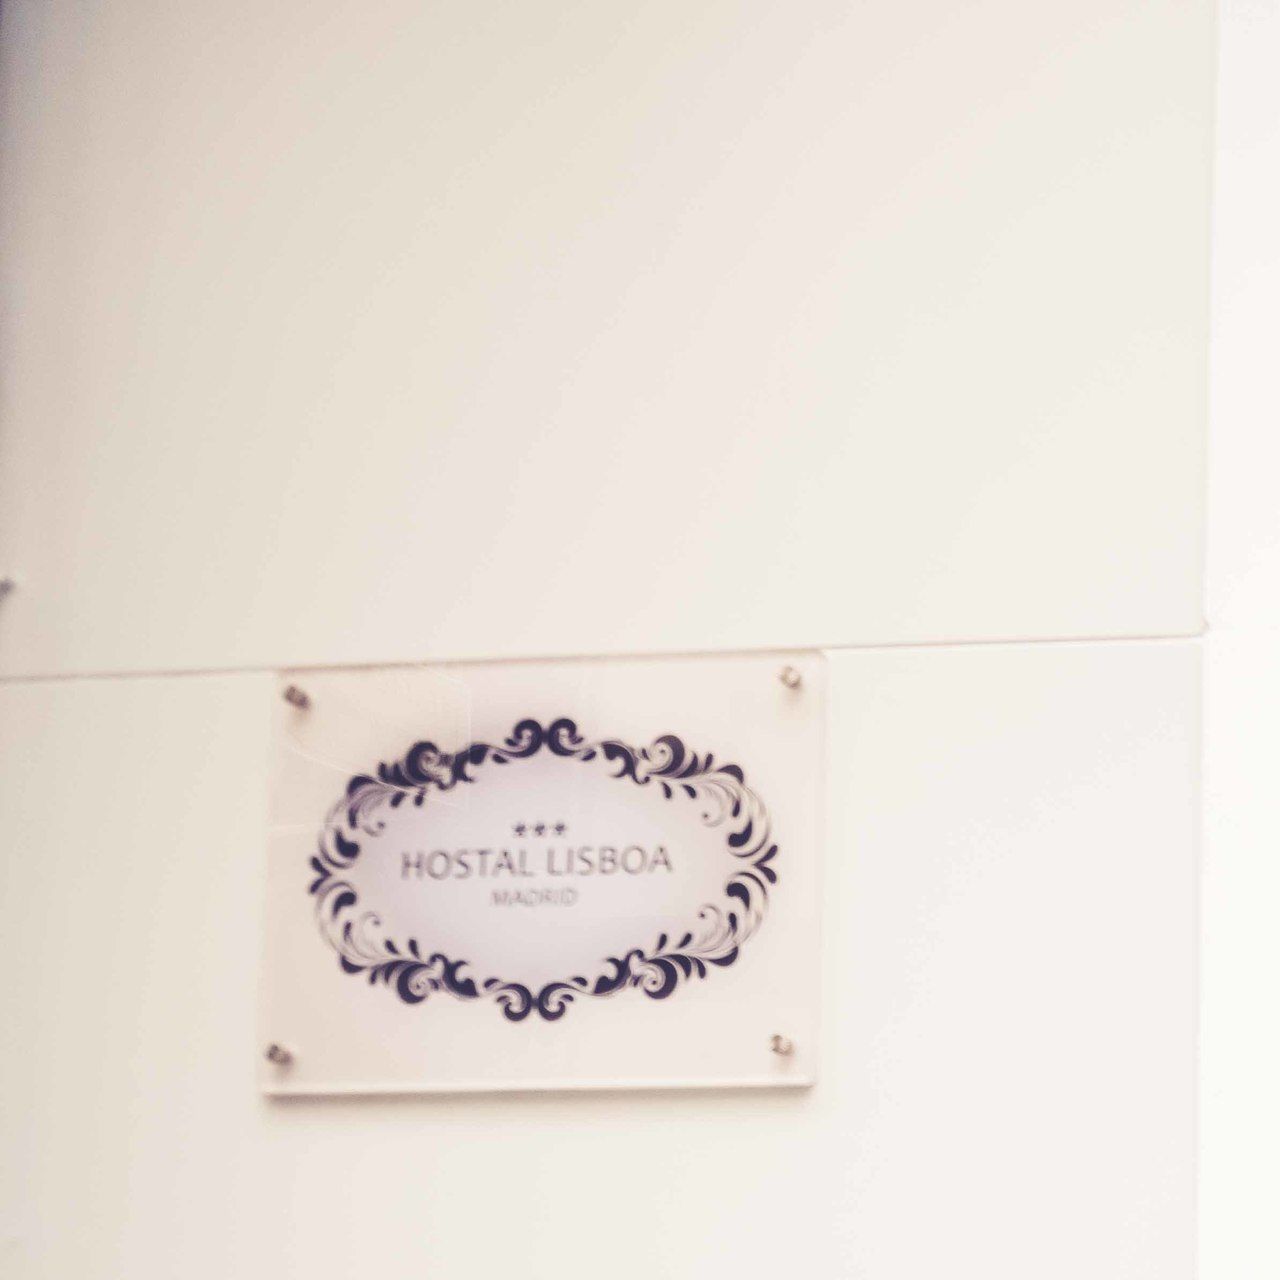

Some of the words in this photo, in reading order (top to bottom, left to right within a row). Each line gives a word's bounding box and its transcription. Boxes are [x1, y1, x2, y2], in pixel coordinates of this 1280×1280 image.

[401, 849, 533, 880] HOSTAL
[547, 845, 673, 876] LISBOA
[492, 888, 577, 906] MADRID
